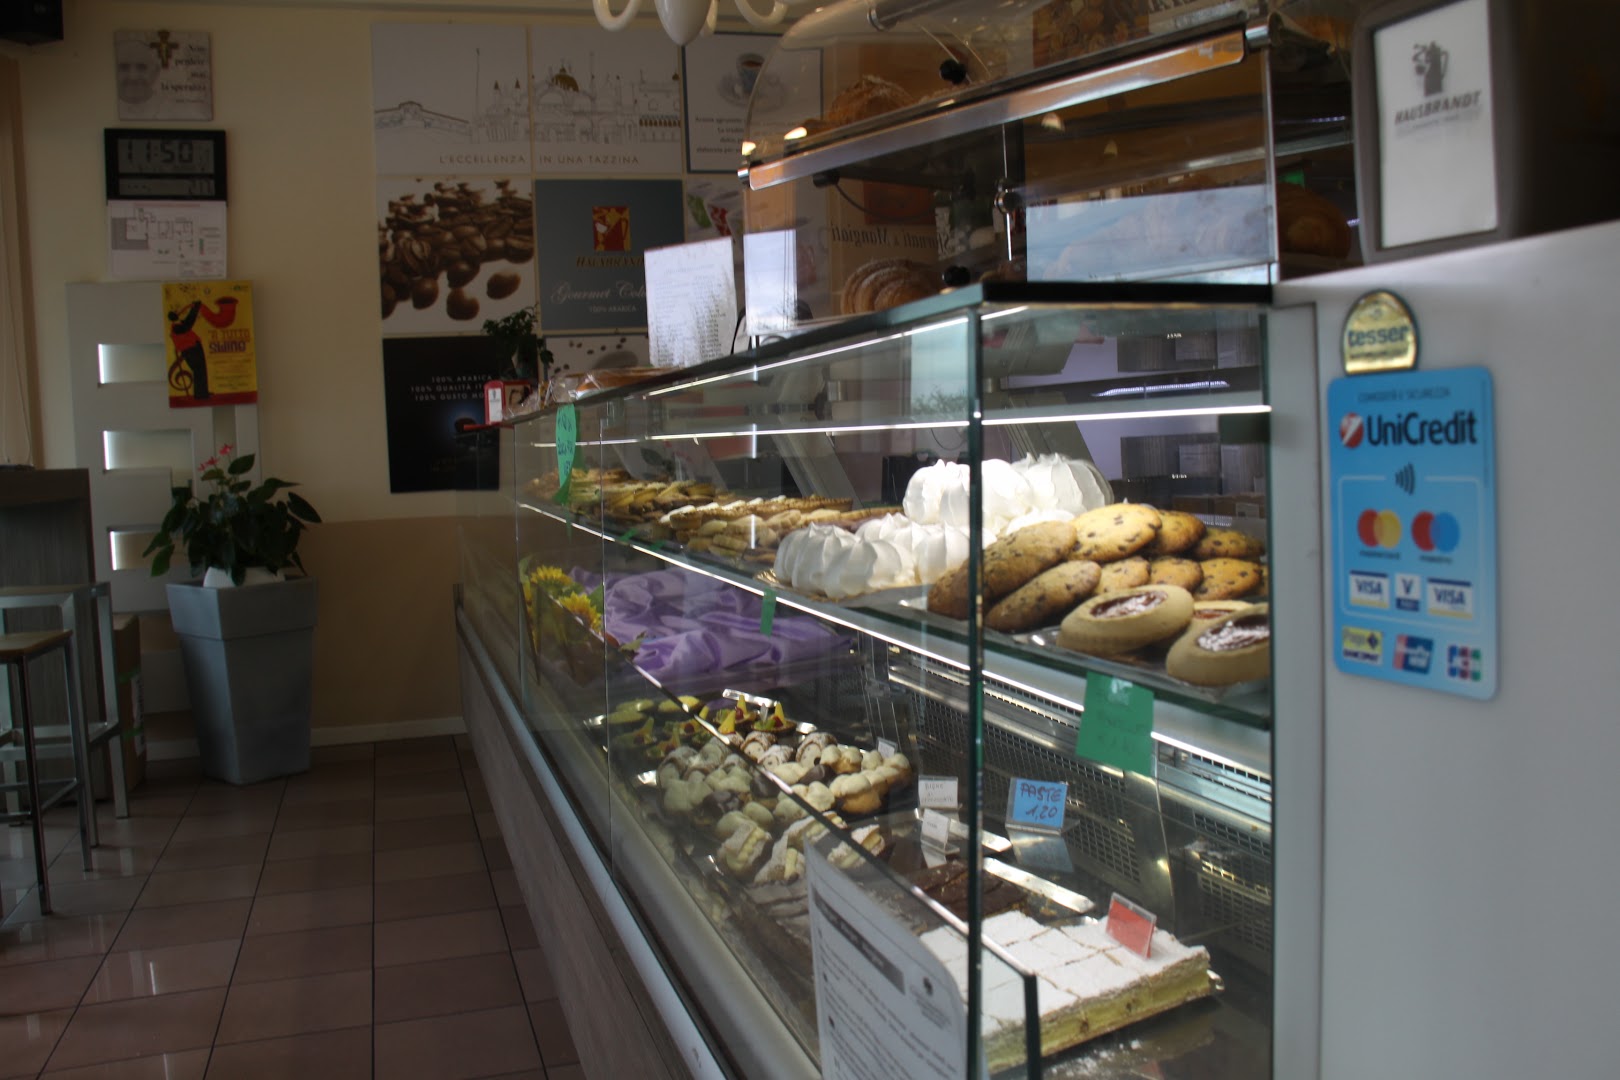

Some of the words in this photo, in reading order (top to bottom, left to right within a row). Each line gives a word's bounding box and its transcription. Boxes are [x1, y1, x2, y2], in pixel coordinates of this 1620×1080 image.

[1395, 91, 1481, 123] HAUSBRANDT
[439, 154, 526, 165] L'ECCELLENZA
[539, 155, 551, 165] IN
[557, 155, 583, 165] UNA
[588, 154, 640, 165] TAZZINA
[550, 280, 611, 305] Gourmet
[608, 304, 637, 313] ARABICA
[1348, 325, 1409, 347] tesser
[431, 376, 454, 384] 100%
[410, 385, 432, 393] 100%
[415, 393, 436, 401] 100%
[440, 392, 467, 400] GUSTO
[1367, 411, 1476, 445] UniCredit
[1355, 578, 1383, 596] VISA
[1434, 588, 1465, 605] VISA
[1020, 782, 1063, 802] PASTE
[1025, 804, 1058, 821] 1,20
